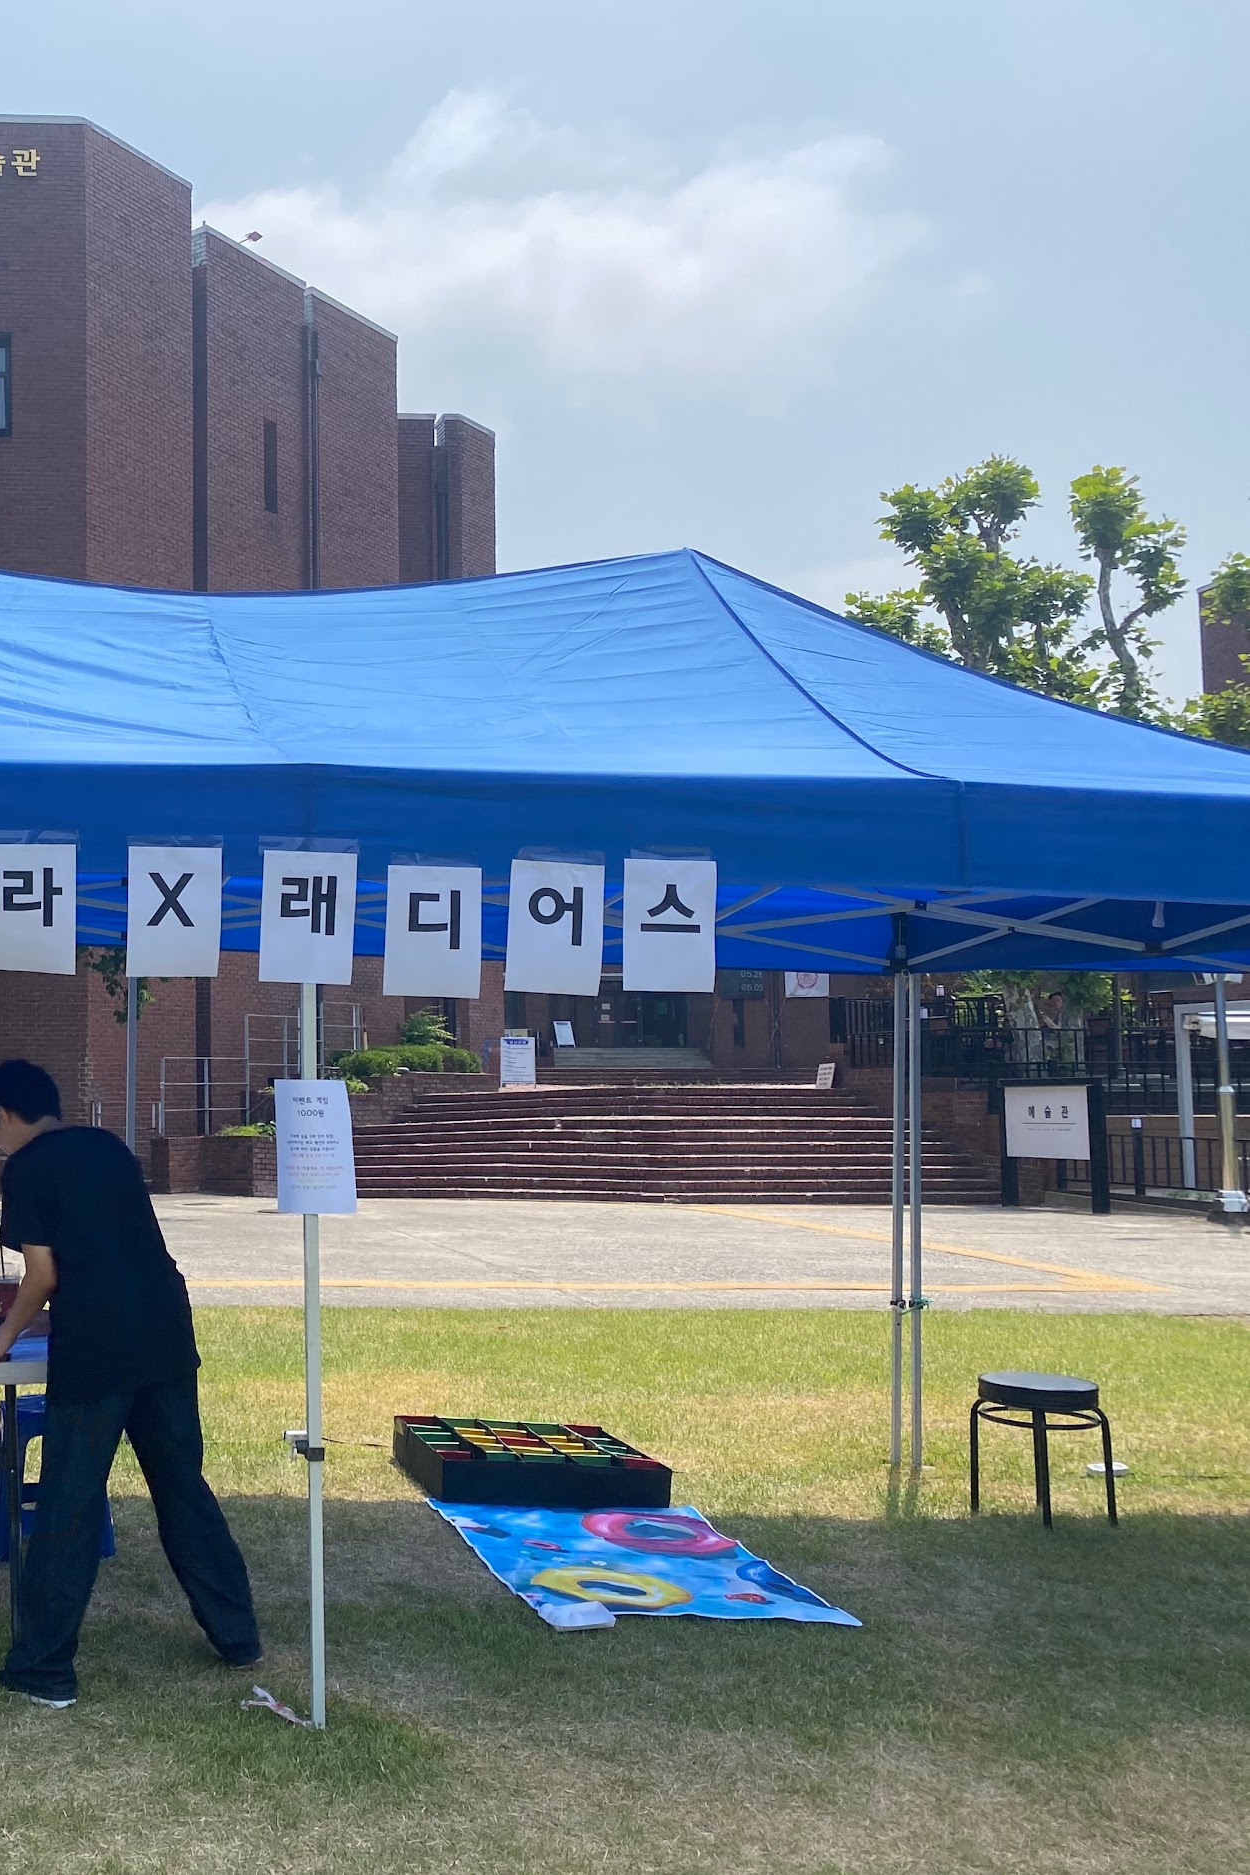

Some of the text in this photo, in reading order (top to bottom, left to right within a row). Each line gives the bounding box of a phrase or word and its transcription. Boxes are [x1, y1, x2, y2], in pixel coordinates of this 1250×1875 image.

[146, 872, 195, 928] X
[292, 1096, 329, 1105] 이벤트 게임
[297, 1109, 325, 1118] 1000원
[1028, 1106, 1068, 1118] 예술관
